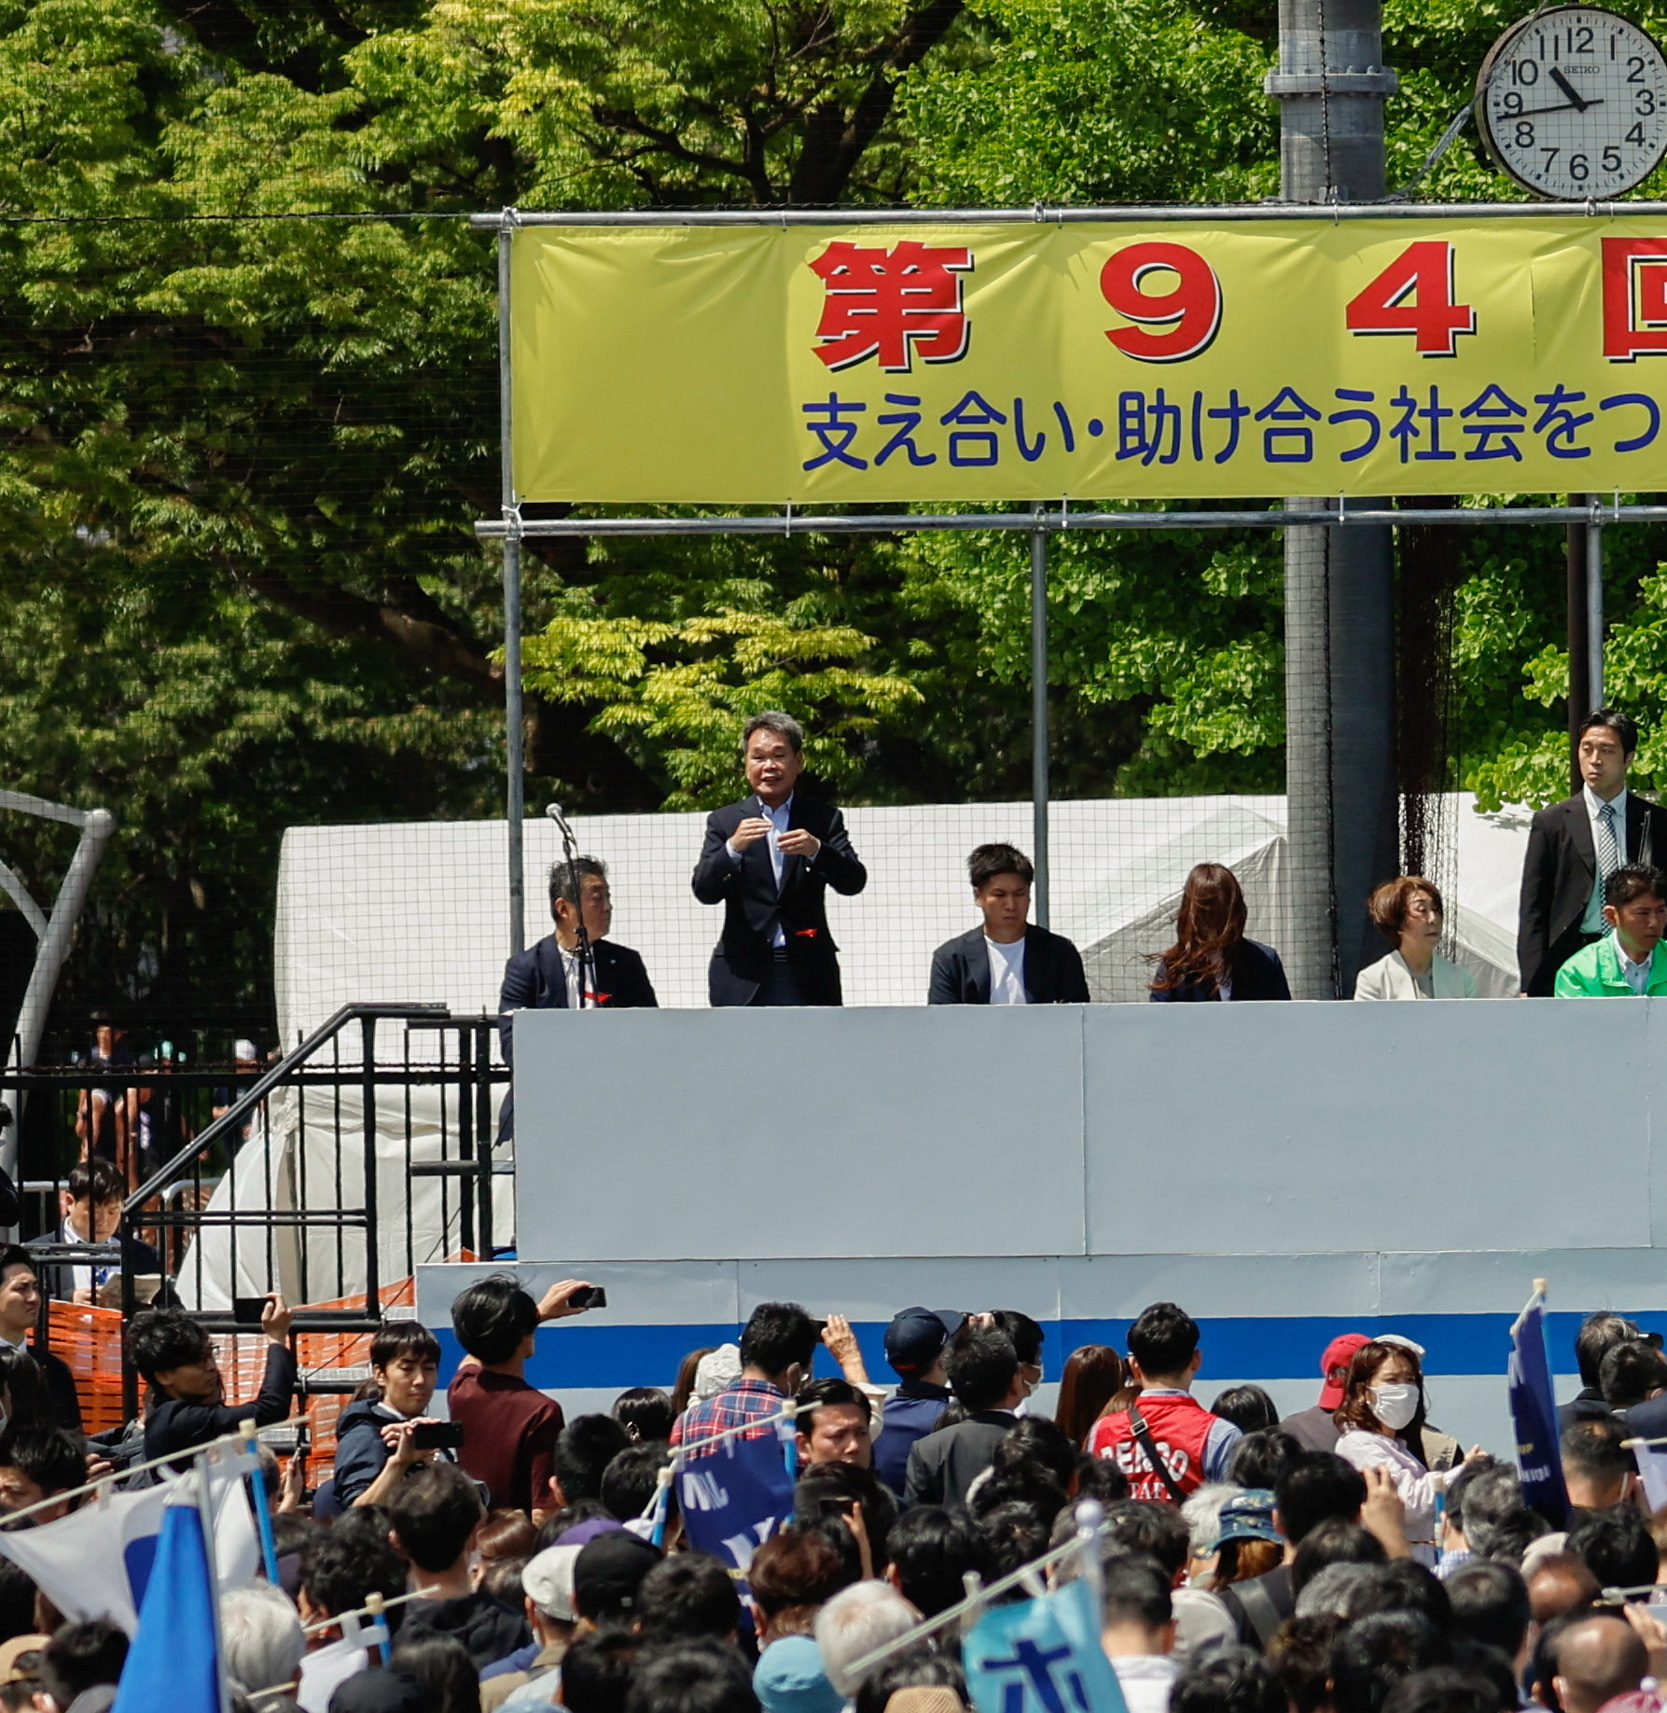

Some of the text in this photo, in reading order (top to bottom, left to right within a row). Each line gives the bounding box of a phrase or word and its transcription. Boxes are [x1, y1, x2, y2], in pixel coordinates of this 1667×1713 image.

[1540, 34, 1559, 61] 11
[1567, 27, 1594, 53] 12
[1512, 59, 1539, 86] 10
[1563, 66, 1600, 75] SEIKO
[1626, 56, 1646, 83] 2
[1503, 92, 1524, 117] 9
[1635, 89, 1656, 116] 3
[1515, 121, 1535, 148] 8
[1625, 121, 1646, 147] 4
[1540, 147, 1560, 173] 7
[1569, 154, 1590, 181] 6
[1602, 146, 1622, 172] 5
